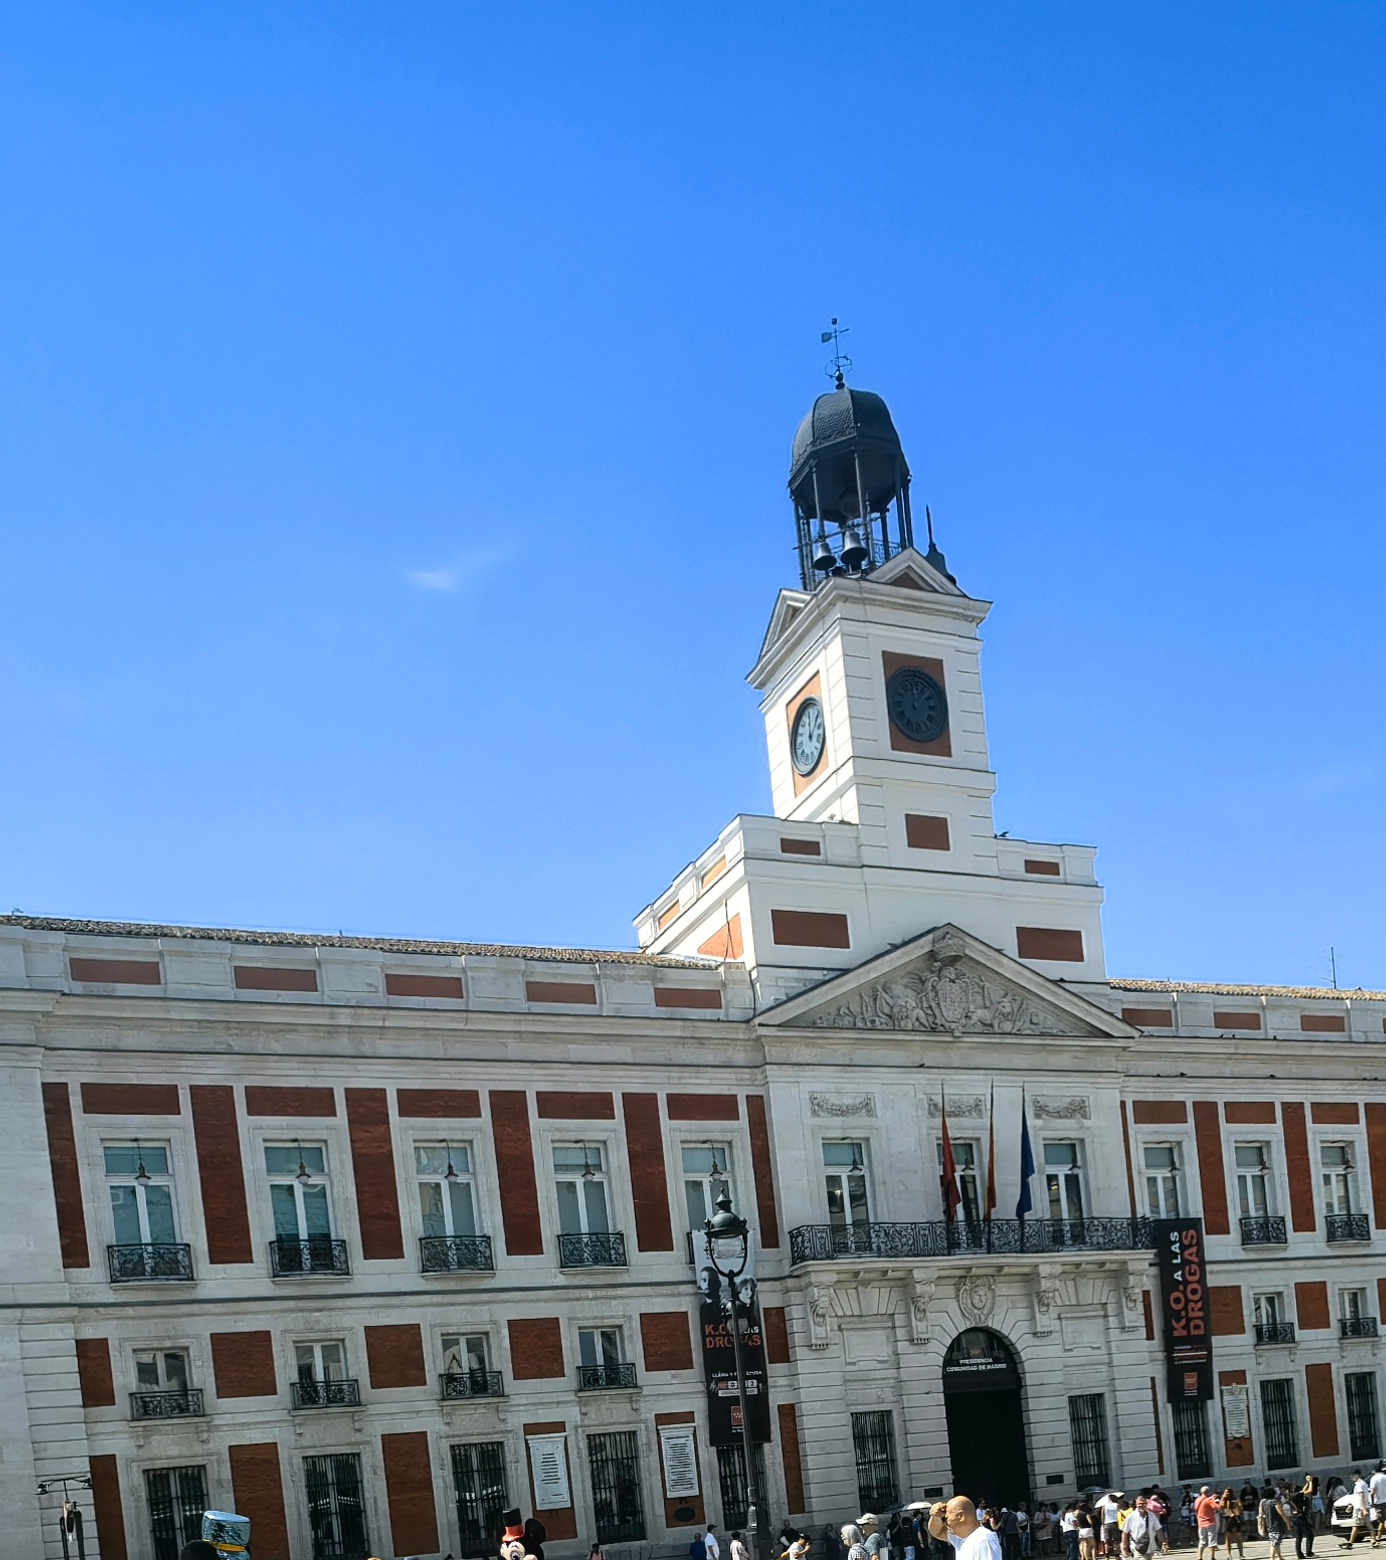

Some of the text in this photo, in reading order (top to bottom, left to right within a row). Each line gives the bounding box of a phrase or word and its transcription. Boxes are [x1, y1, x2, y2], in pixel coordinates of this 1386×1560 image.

[1170, 1231, 1188, 1337] K.O. A LAS
[1182, 1229, 1206, 1336] DROGAS
[706, 1334, 762, 1348] DROAS
[959, 1357, 993, 1365] PRESIDENCIA
